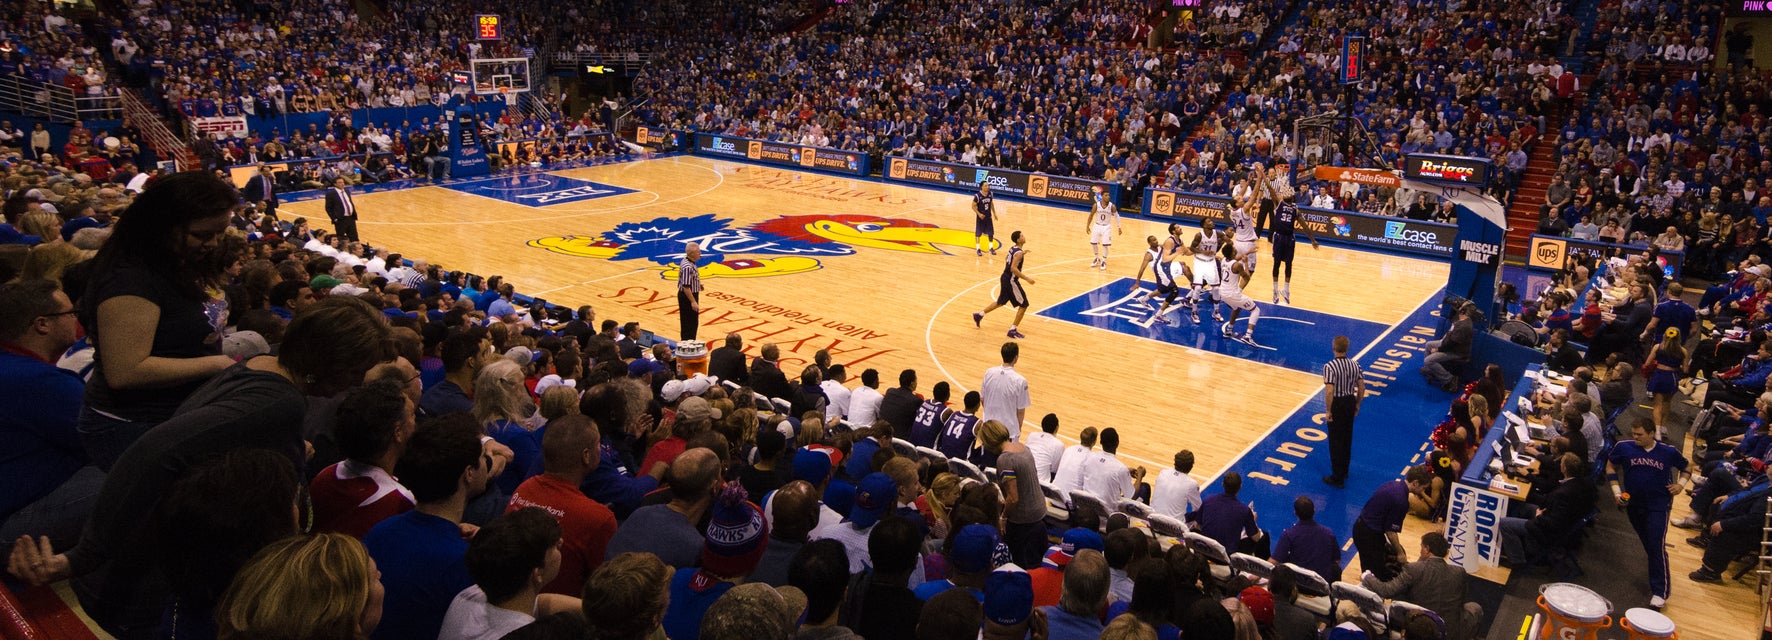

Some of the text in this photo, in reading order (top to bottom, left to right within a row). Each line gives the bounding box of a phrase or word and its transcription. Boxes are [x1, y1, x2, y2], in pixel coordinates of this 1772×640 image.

[1743, 1, 1764, 11] PINK
[481, 25, 496, 38] 35
[198, 121, 243, 133] ESPN
[1421, 160, 1474, 178] Briggs
[1048, 188, 1090, 200] UPS DRIVE.
[1442, 186, 1460, 198] KU
[1156, 198, 1169, 208] ups
[1176, 198, 1206, 208] JAYHAWK
[1175, 204, 1224, 219] UPS DRIVE.
[1280, 212, 1292, 222] 32
[1386, 220, 1437, 244] EZcase
[1368, 236, 1392, 244] world's
[1408, 241, 1432, 250] contact
[1433, 244, 1447, 252] lens
[1460, 240, 1499, 256] MUSCLE
[1466, 250, 1490, 264] MILK
[1538, 246, 1556, 260] ups
[705, 291, 888, 340] Allen Fieldhouse
[914, 406, 936, 427] 33
[946, 420, 966, 439] 14
[1630, 458, 1665, 471] KANSAS
[546, 506, 566, 518] Bank
[1475, 493, 1498, 560] ROCK
[695, 574, 708, 587] KU
[1560, 626, 1576, 640] G
